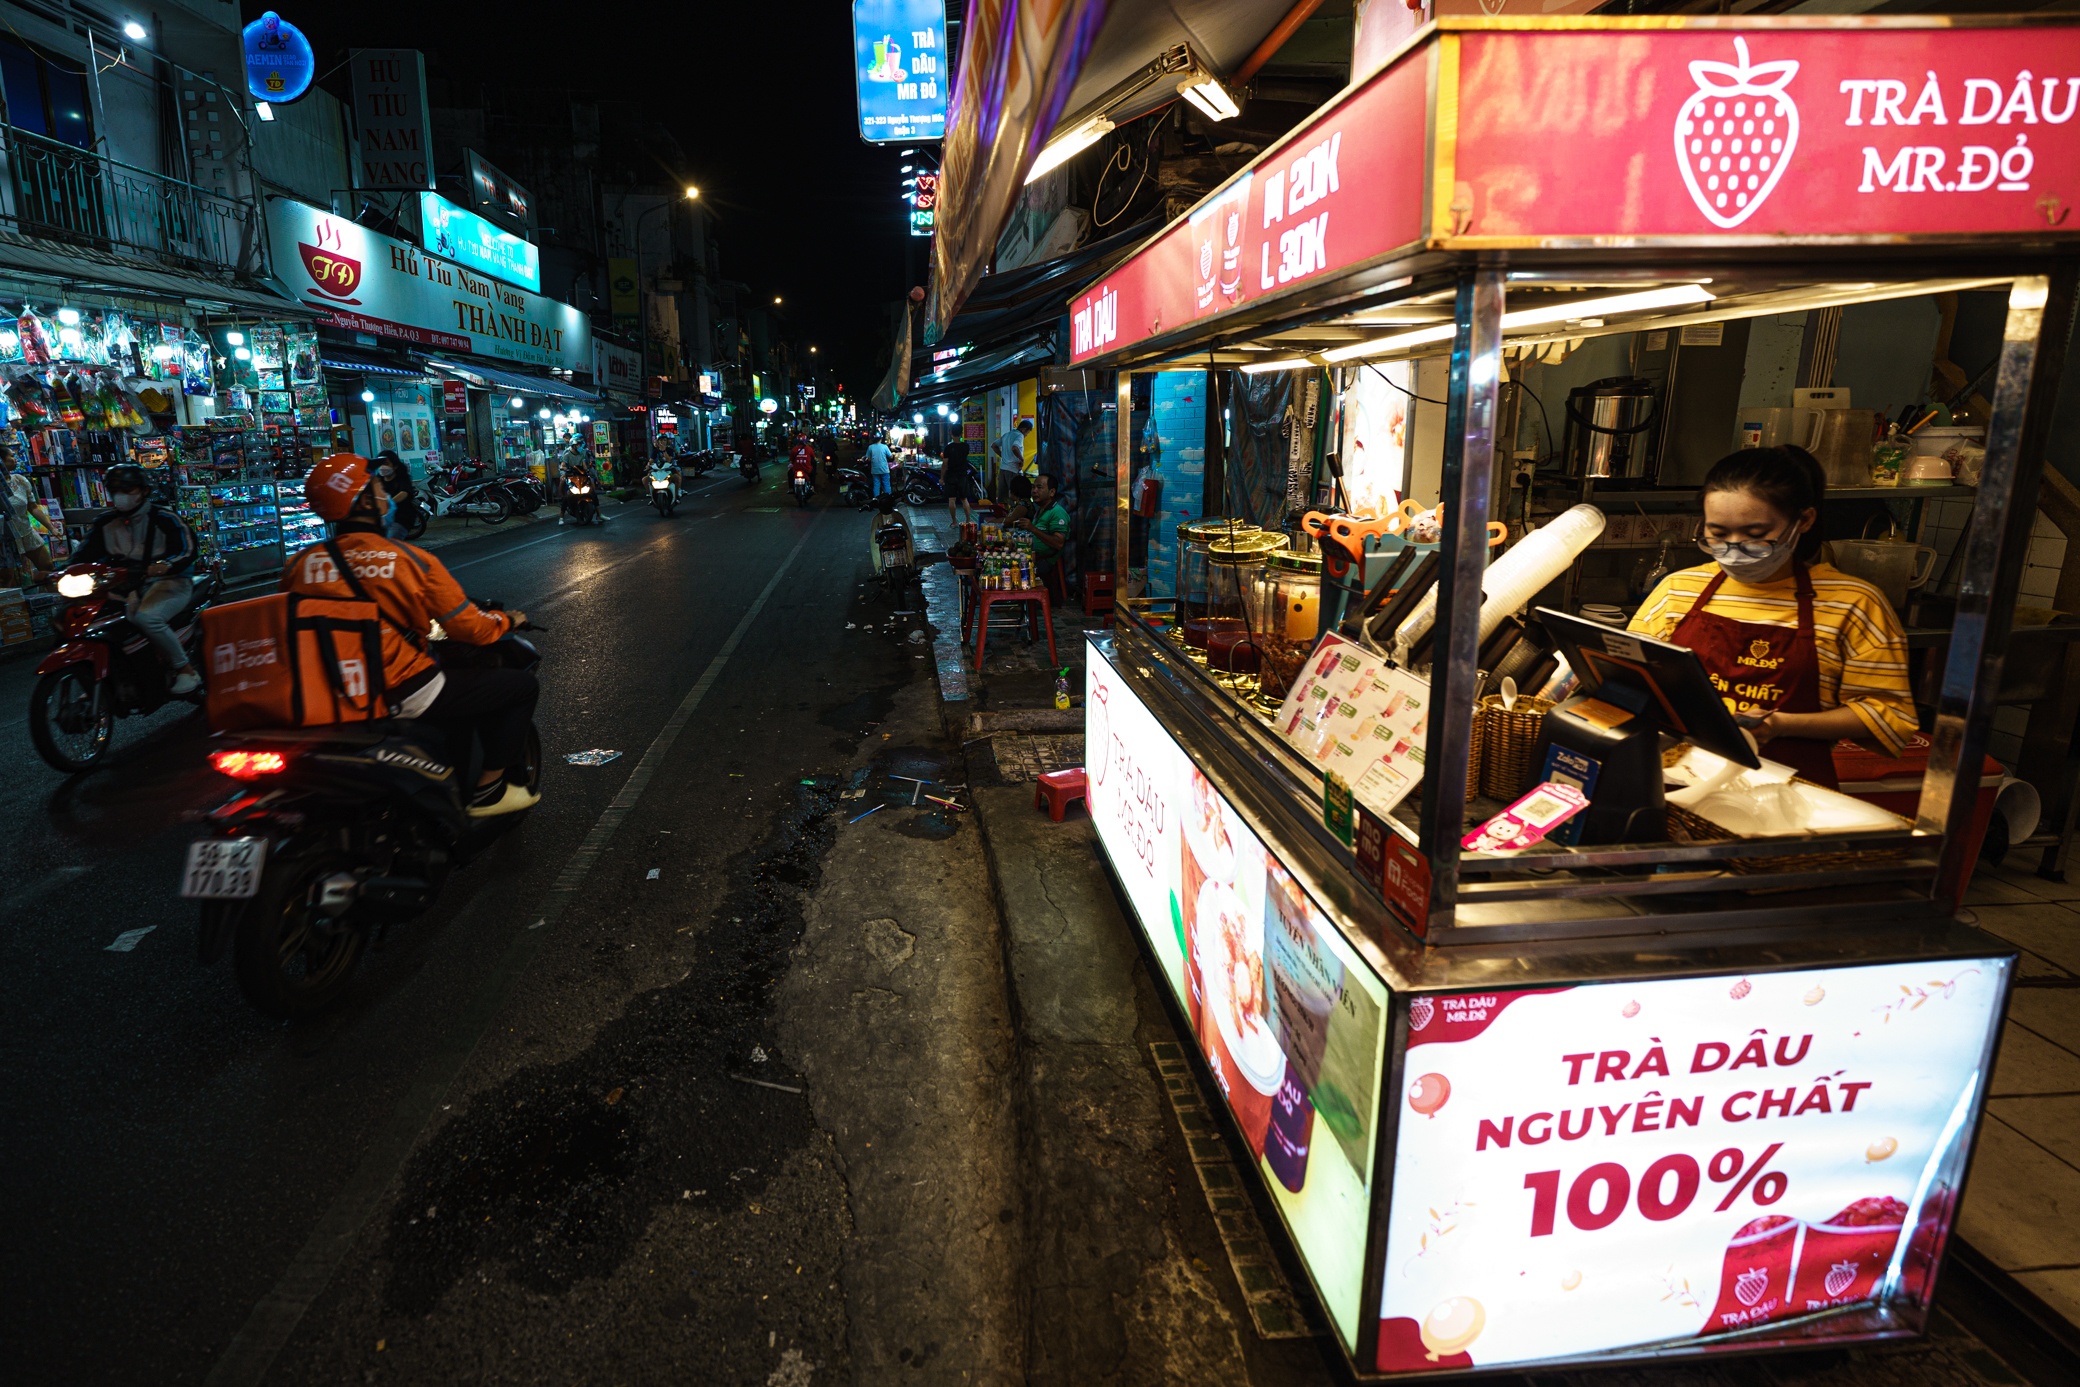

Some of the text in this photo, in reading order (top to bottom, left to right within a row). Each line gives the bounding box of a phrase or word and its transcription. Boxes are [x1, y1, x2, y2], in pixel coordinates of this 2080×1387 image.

[911, 27, 935, 49] TRÀ
[246, 53, 282, 66] AEMIN
[368, 53, 401, 83] HỦ
[911, 52, 936, 75] DÂU
[368, 87, 408, 117] TÍU
[897, 77, 938, 101] MR ĐỎ
[1839, 69, 2080, 127] TRÀ DÂU
[366, 128, 418, 151] NAM
[911, 126, 916, 135] 3
[364, 161, 426, 185] VANG
[1857, 133, 2035, 193] MR.ĐỎ
[1263, 131, 1342, 230] M 20K
[1261, 241, 1275, 290] L
[1278, 212, 1329, 284] 30K
[389, 244, 525, 314] Hủ Tíu Nam Vang
[359, 318, 383, 335] Thượng
[416, 332, 420, 341] 3
[453, 300, 564, 354] THÀNH ĐẠT
[1074, 286, 1118, 355] TRÀ DÂU
[350, 561, 396, 579] ood
[1735, 683, 1784, 701] CHẤT
[376, 750, 445, 774] VARIO
[1362, 817, 1381, 844] mo
[1361, 835, 1380, 862] mo
[1561, 1028, 1814, 1086] TRÀ DÂU
[1475, 1070, 1873, 1152] NGUYÊN CHẤT
[1523, 1141, 1789, 1238] 100%
